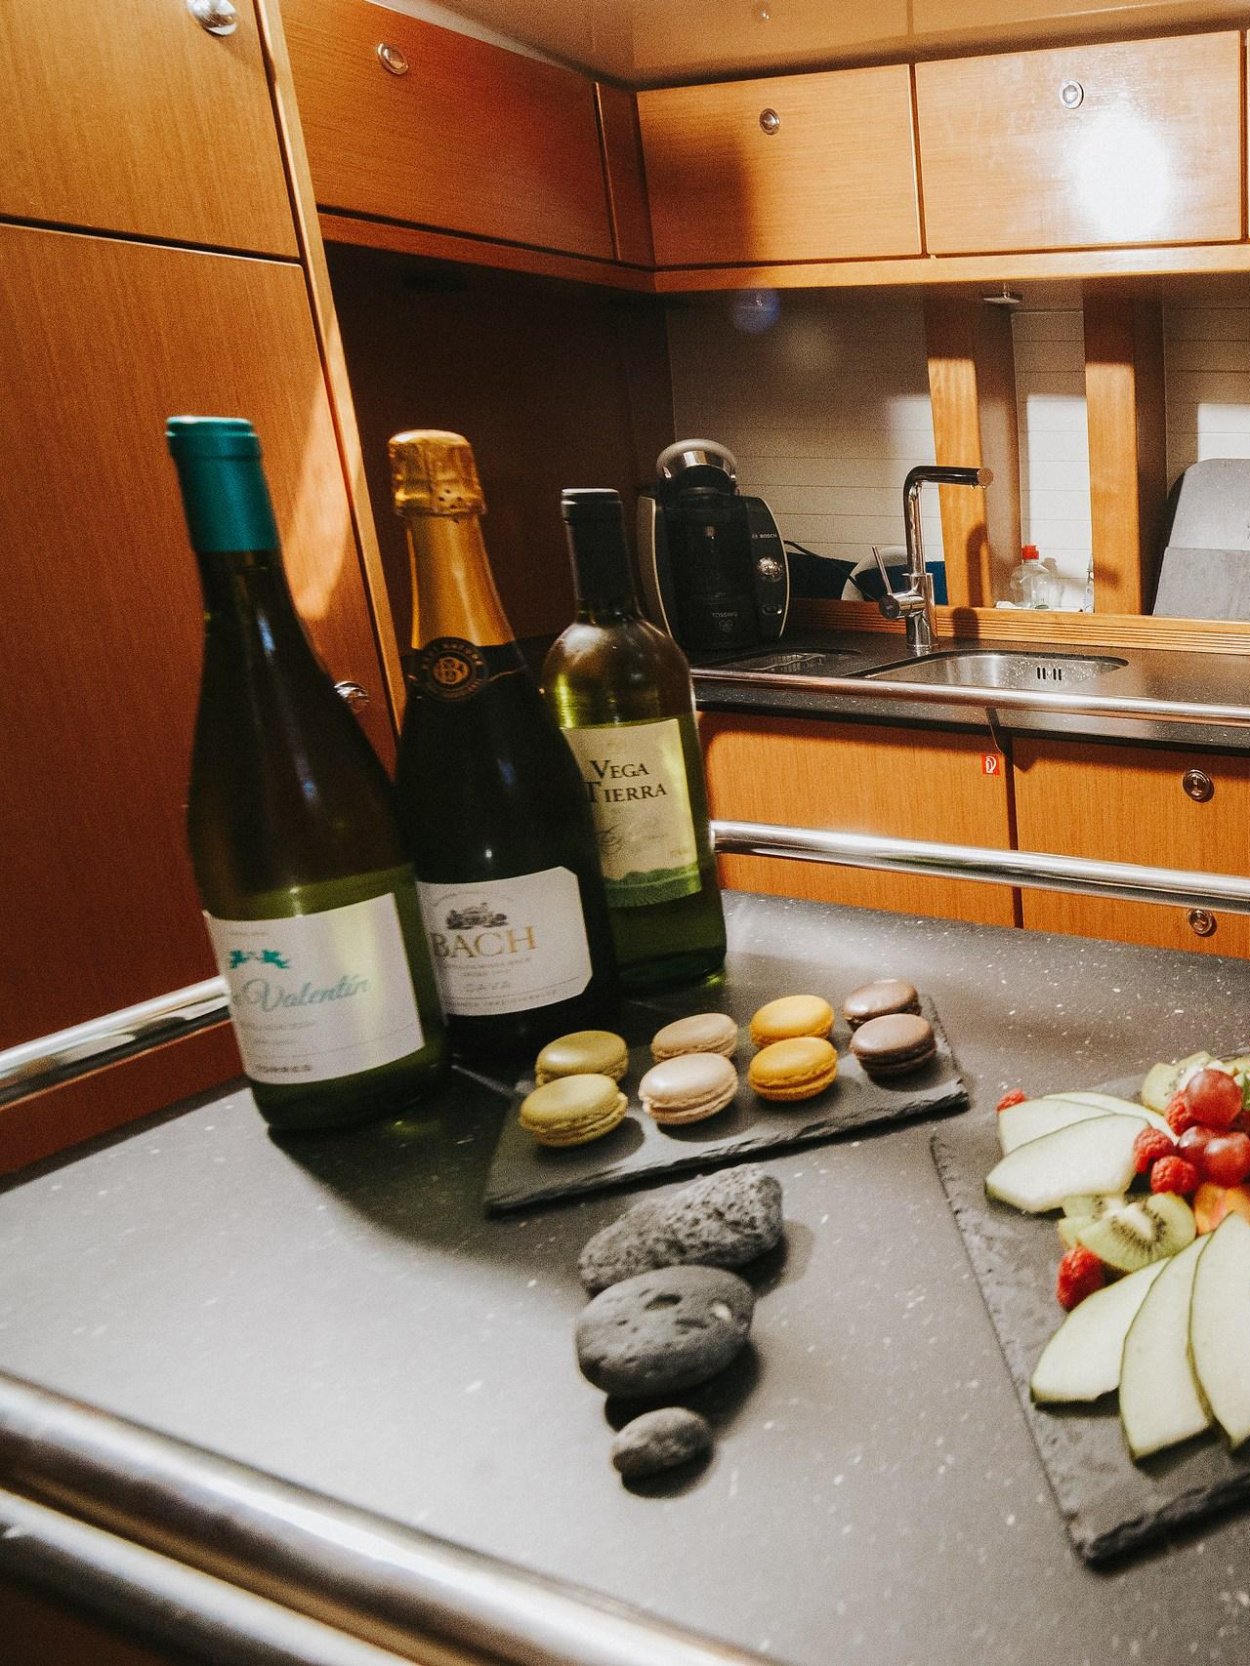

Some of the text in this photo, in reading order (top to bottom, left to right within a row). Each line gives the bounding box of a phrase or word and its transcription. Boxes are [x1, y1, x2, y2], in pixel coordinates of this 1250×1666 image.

[590, 760, 650, 779] VEGA
[581, 781, 667, 803] TIERRA
[430, 925, 537, 958] BACH
